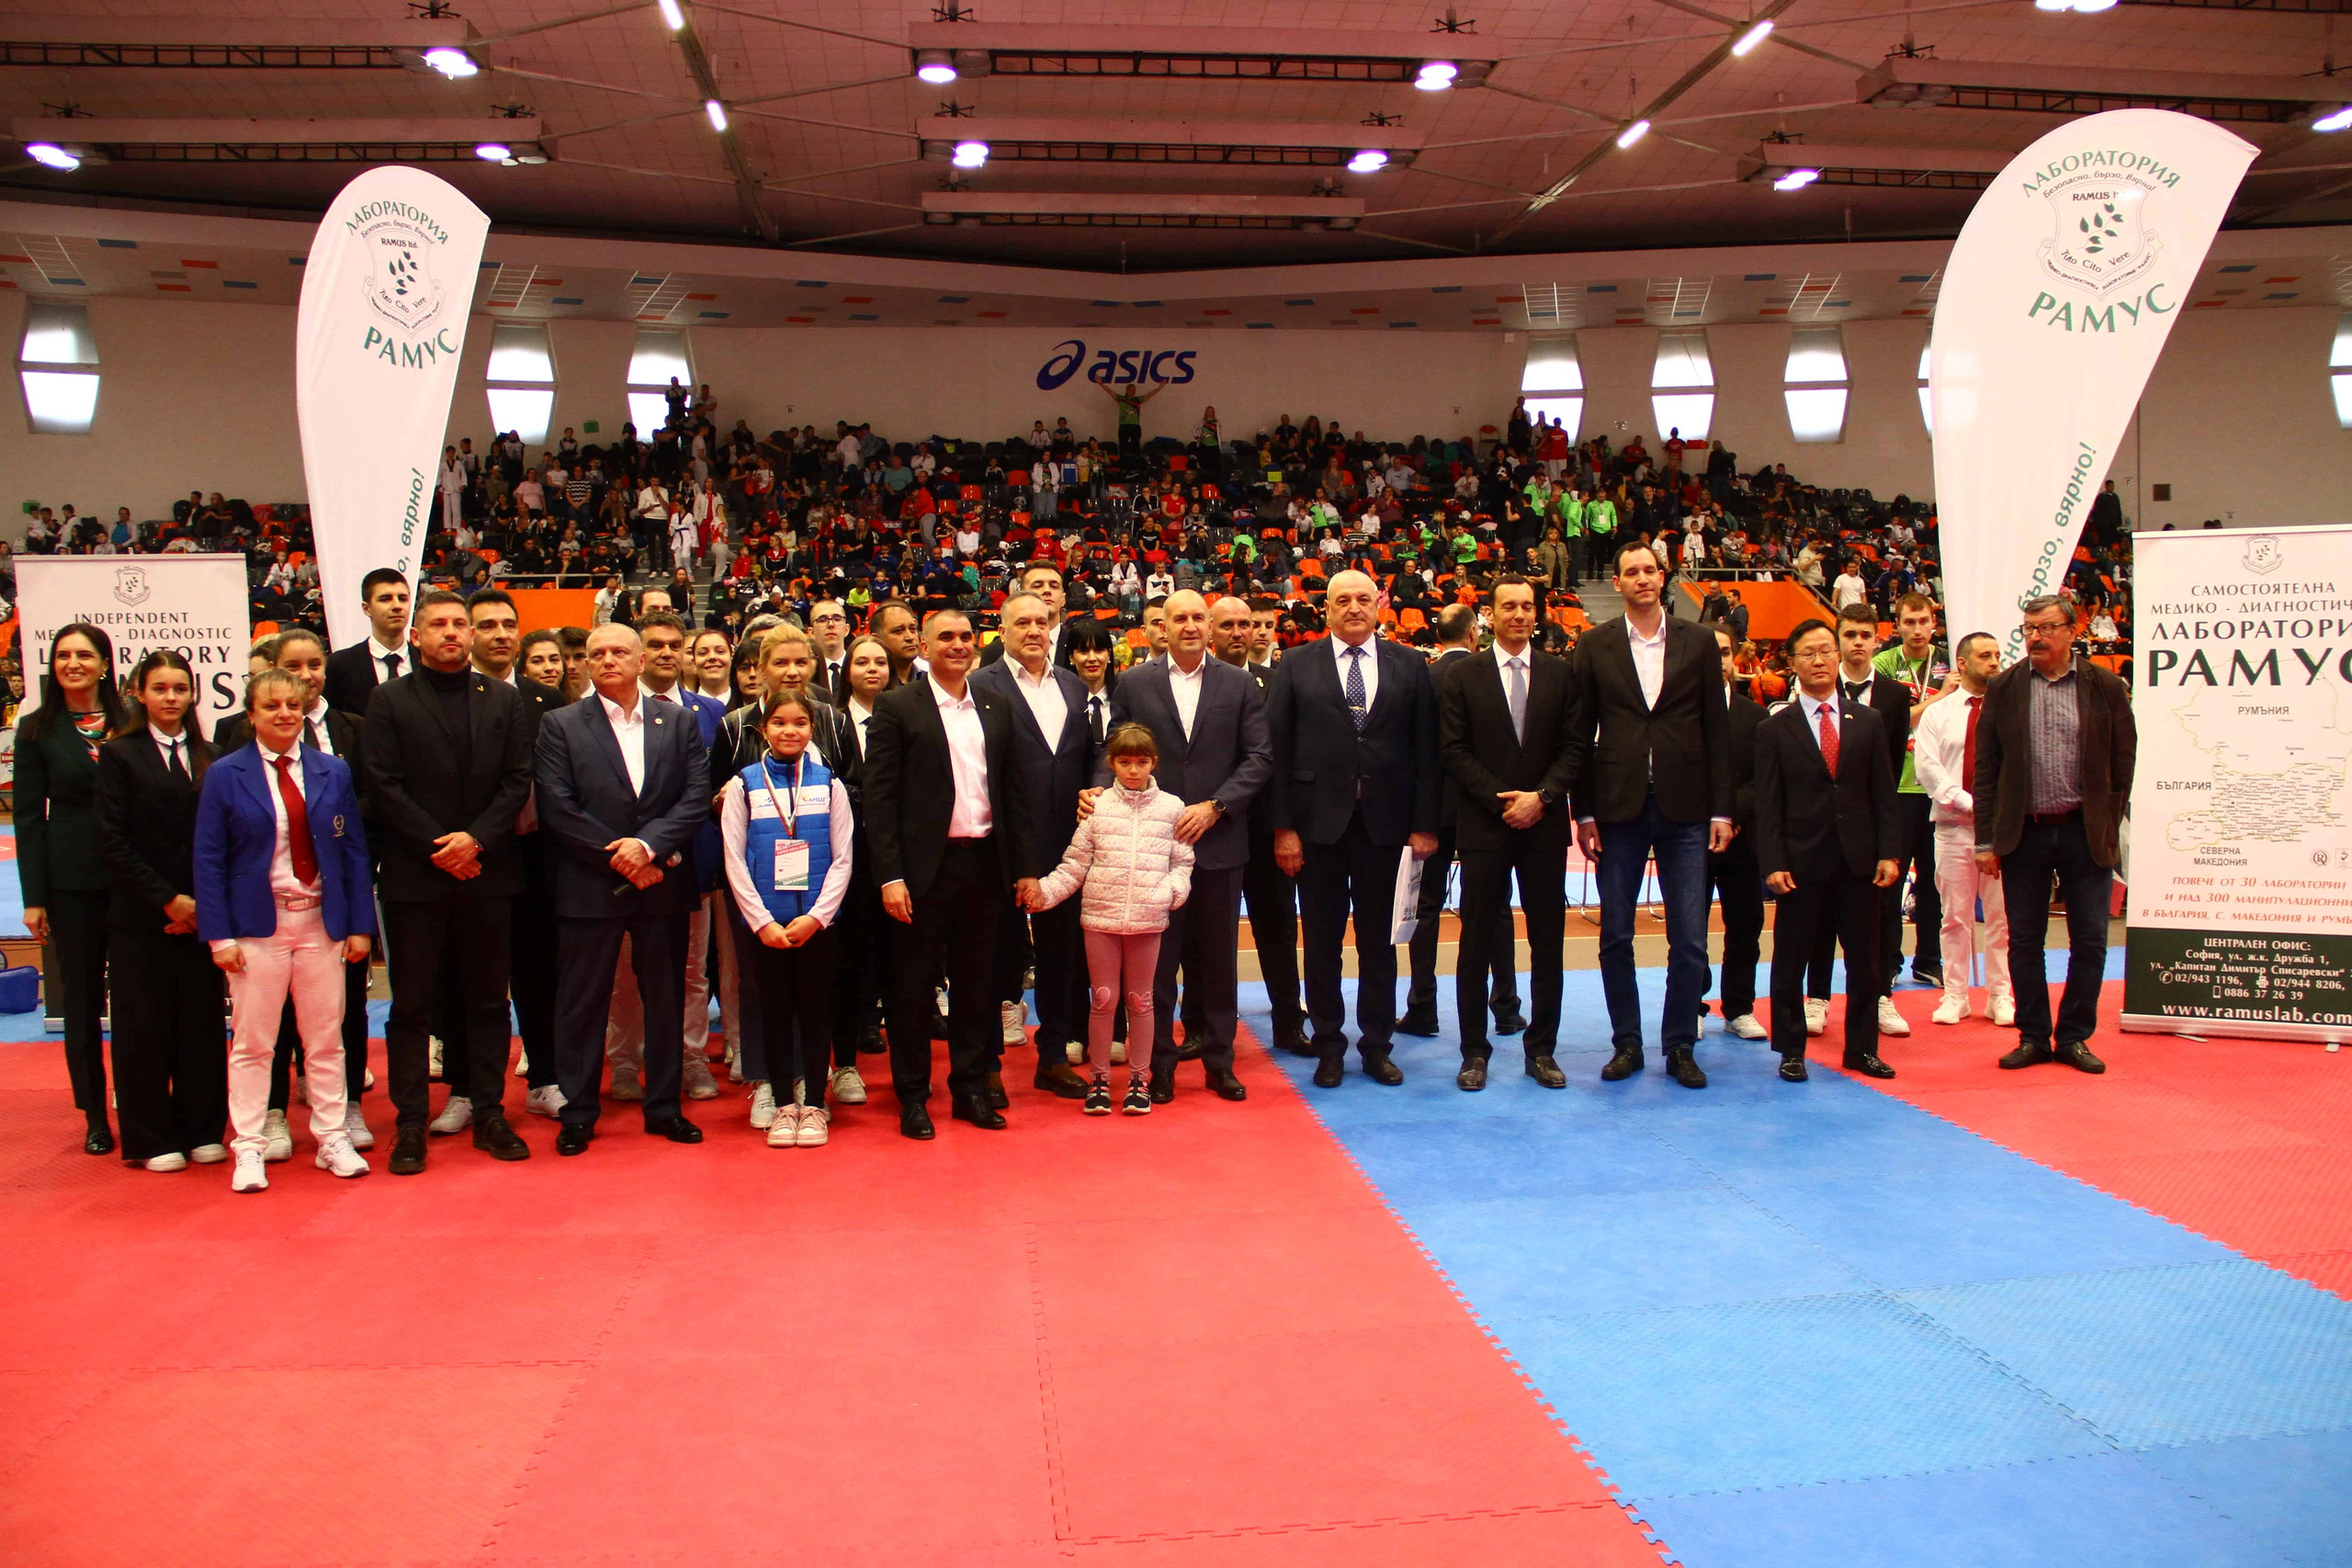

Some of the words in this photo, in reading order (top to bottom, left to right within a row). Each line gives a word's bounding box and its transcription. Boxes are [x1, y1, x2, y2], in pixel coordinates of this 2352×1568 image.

[2022, 150, 2182, 197] ЛАБОРАТОРИЯ
[2073, 191, 2110, 201] RAMUS
[345, 200, 449, 245] ЛАБОРАТОРИЯ
[380, 237, 407, 248] RAMUS
[2082, 258, 2102, 274] Cito
[2109, 251, 2131, 266] Vere
[395, 299, 411, 314] Cito
[413, 296, 427, 309] Vere
[2028, 282, 2176, 333] РАМУС
[363, 325, 458, 369] РАМУС
[1087, 351, 1197, 384] asics
[2054, 441, 2098, 528] вярно!
[401, 467, 425, 547] вярно!
[2191, 581, 2335, 596] САМОСТОЯТЕЛНА
[2151, 602, 2217, 615] МЕДИКО
[74, 612, 189, 625] INDEPENDENT
[129, 626, 232, 640] DIAGNOSTIC
[2238, 705, 2290, 716] РУМЪНИЯ
[2156, 781, 2212, 791] БЪЛГАРИЯ
[2199, 846, 2241, 855] СЕВЕРНА
[2193, 857, 2248, 867] МАКЕДОНИЯ
[2172, 876, 2215, 886] ПОВЕЧЕ
[2220, 877, 2236, 886] ОТ
[2240, 876, 2257, 887] 30
[2261, 879, 2346, 890] ЛАБОРАТОРИИ
[2165, 893, 2174, 901] И
[2177, 894, 2201, 902] НАД
[2206, 892, 2230, 903] 300
[2142, 908, 2149, 917] В
[2215, 911, 2225, 920] С.
[2231, 912, 2302, 922] МАКЕДОНИЯ
[2307, 915, 2316, 923] И
[2204, 938, 2267, 949] ЦЕНТРАЛЕН
[2272, 940, 2312, 951] ОФИС:
[2186, 949, 2223, 962] София,
[2228, 953, 2243, 962] ул.
[2247, 953, 2268, 962] ж.к.
[2273, 953, 2314, 964] Дружба
[2320, 954, 2330, 965] 1,
[2150, 961, 2165, 971] ул.
[2169, 961, 2216, 971] „Капитан
[2220, 963, 2267, 976] Димитър
[2175, 973, 2211, 984] 02/943
[2215, 975, 2244, 986] 1196,
[2273, 977, 2311, 988] 02/944
[2315, 979, 2346, 991] 8206,
[2224, 987, 2250, 998] 0886
[2254, 989, 2267, 998] 37
[2272, 990, 2286, 999] 26
[2290, 990, 2303, 999] 39
[2162, 1004, 2352, 1025] www.ramuslab.com
